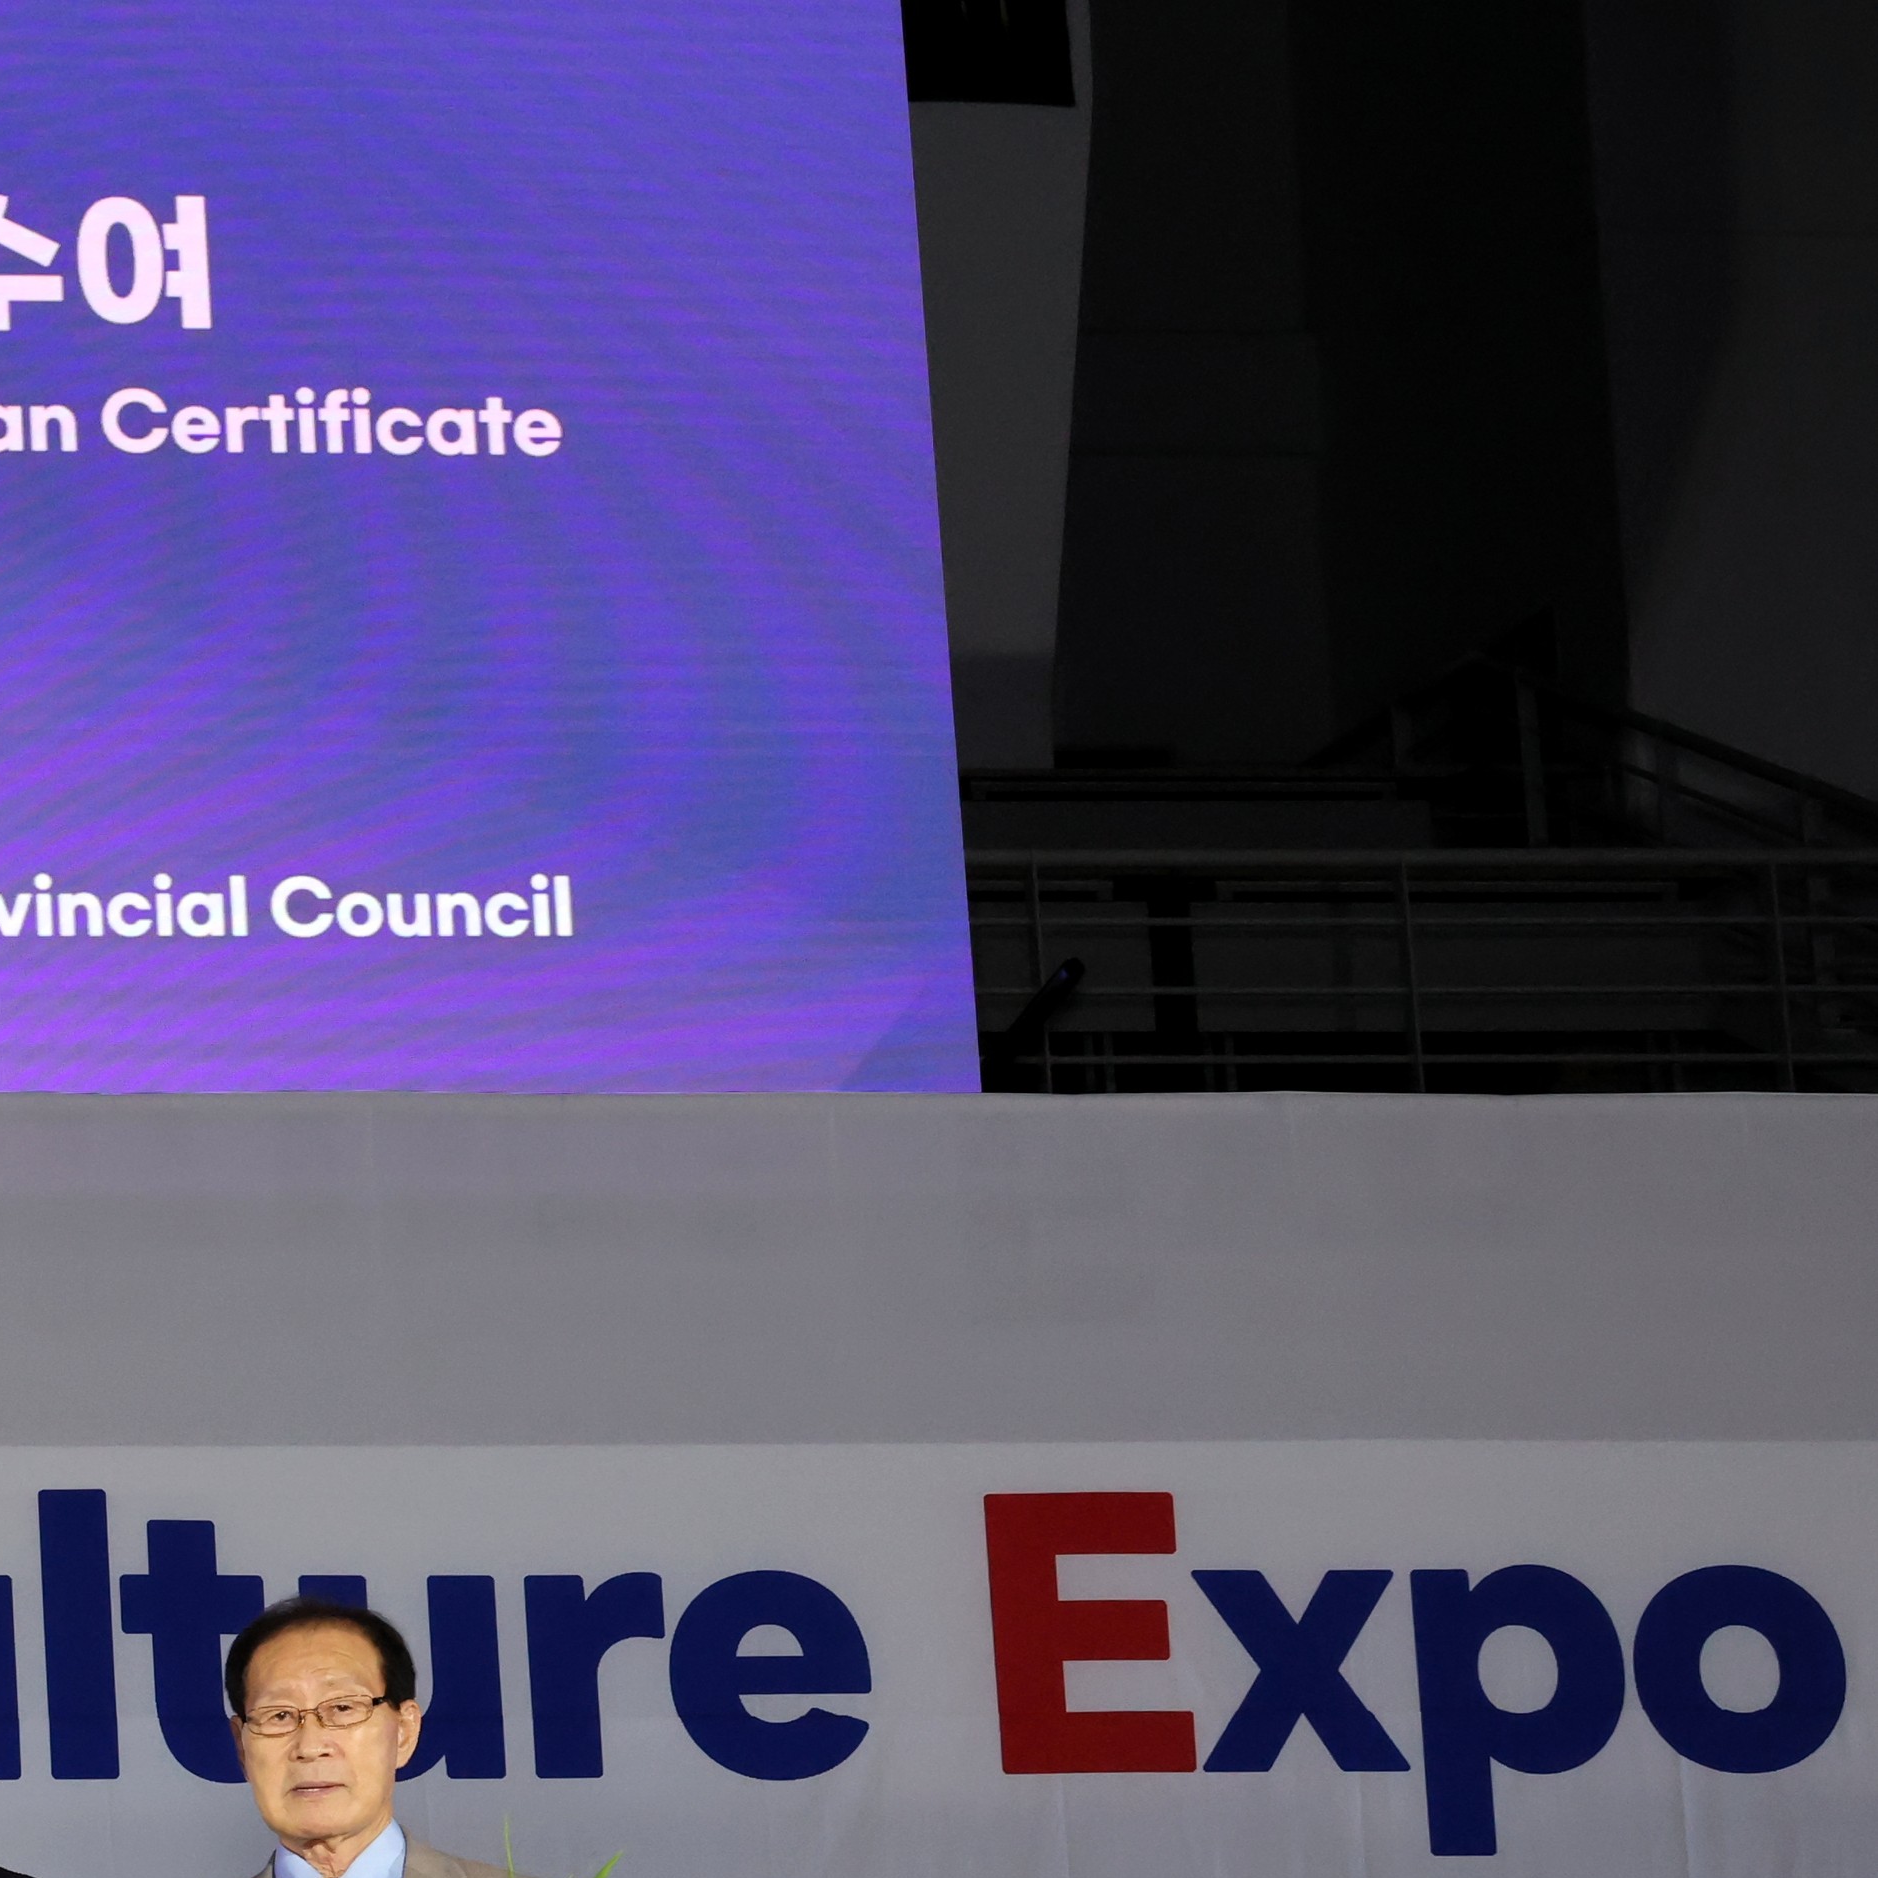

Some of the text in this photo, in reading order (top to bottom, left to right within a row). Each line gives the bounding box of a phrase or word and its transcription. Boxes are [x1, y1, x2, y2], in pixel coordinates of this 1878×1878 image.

[101, 386, 563, 457] Certificate
[270, 874, 574, 939] Council
[982, 1491, 1847, 1857] Expo
